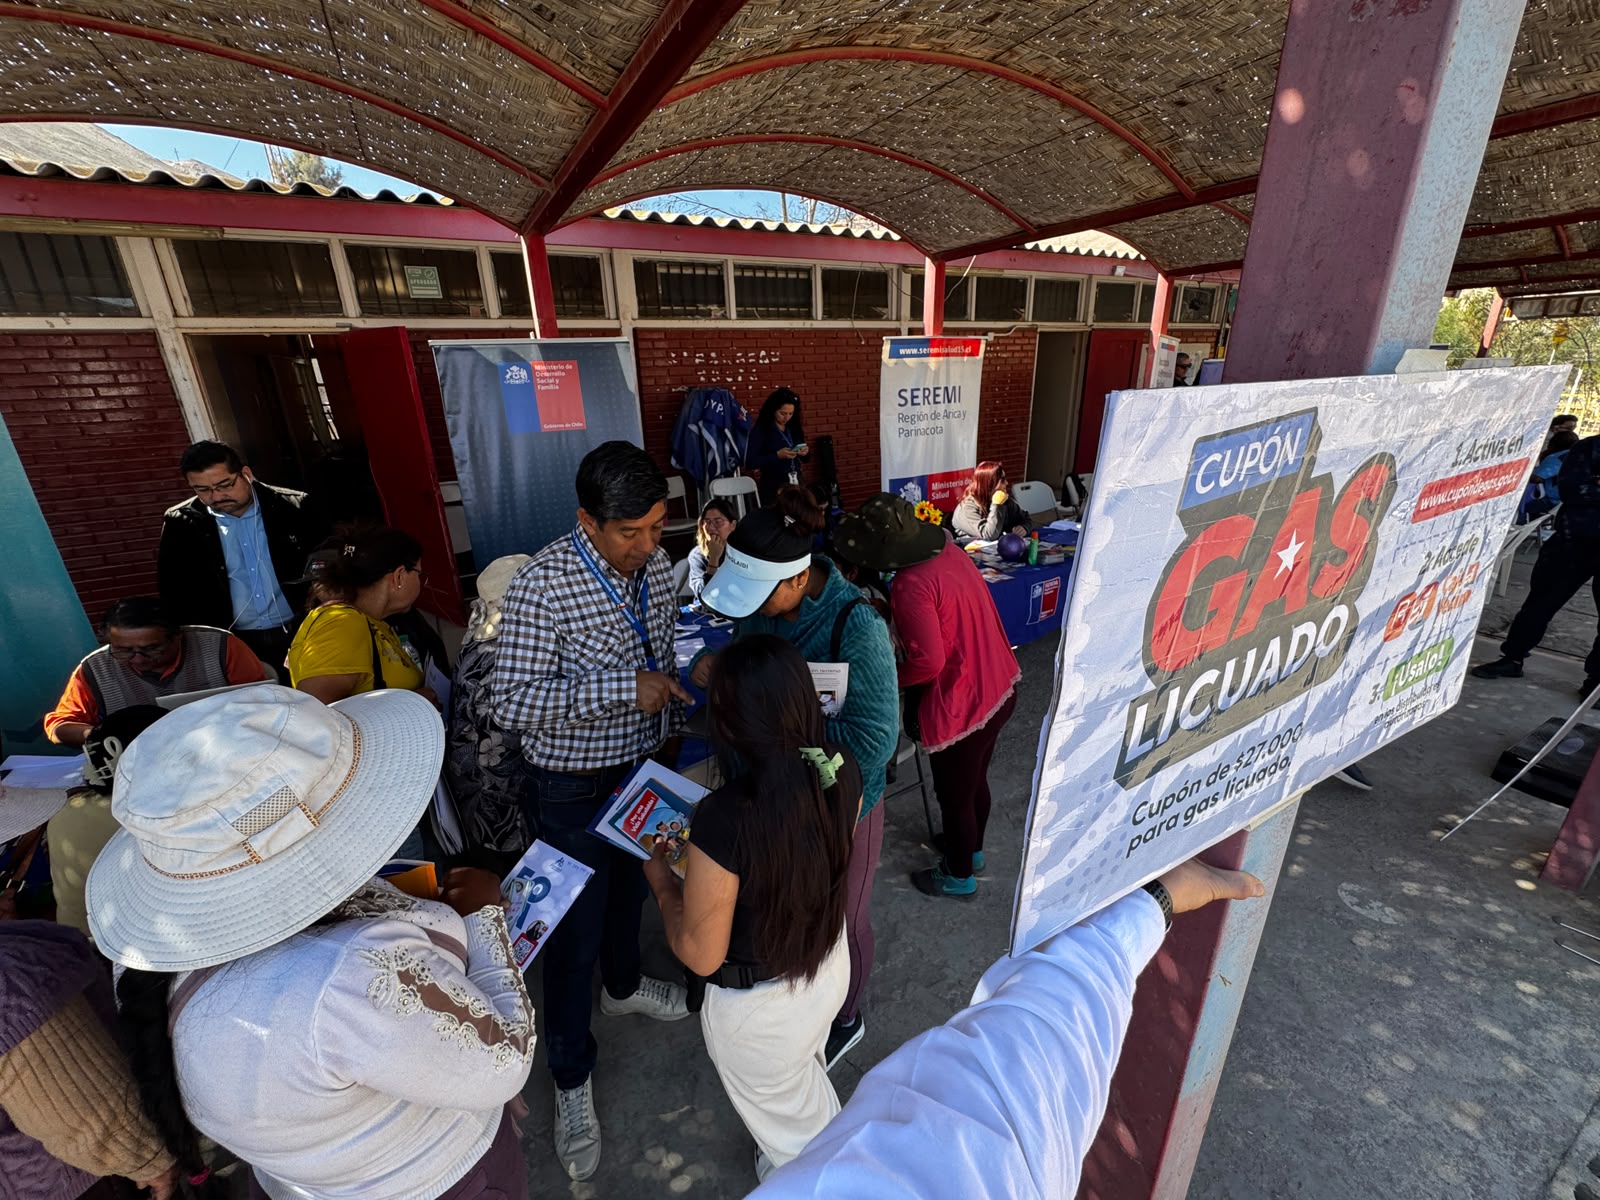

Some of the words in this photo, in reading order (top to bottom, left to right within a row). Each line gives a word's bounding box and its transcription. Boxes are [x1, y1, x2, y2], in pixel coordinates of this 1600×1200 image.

[899, 345, 972, 355] www.seremisalud15.cl
[897, 385, 961, 407] SEREMI
[897, 411, 929, 425] Región
[930, 410, 941, 421] de
[942, 409, 961, 420] Arica
[898, 426, 944, 438] Parinacota
[1507, 435, 1524, 454] en
[1195, 425, 1302, 495] CUPÓN
[931, 480, 964, 491] Ministerio
[931, 490, 950, 500] Salud
[1151, 463, 1390, 672] GAS
[1124, 604, 1349, 764] LICUADO
[1131, 779, 1201, 826] Cupón
[1205, 763, 1230, 787] de
[1235, 722, 1304, 772] $27.000
[1125, 812, 1180, 859] para
[1183, 792, 1220, 827] gas
[1223, 755, 1292, 801] licuado.
